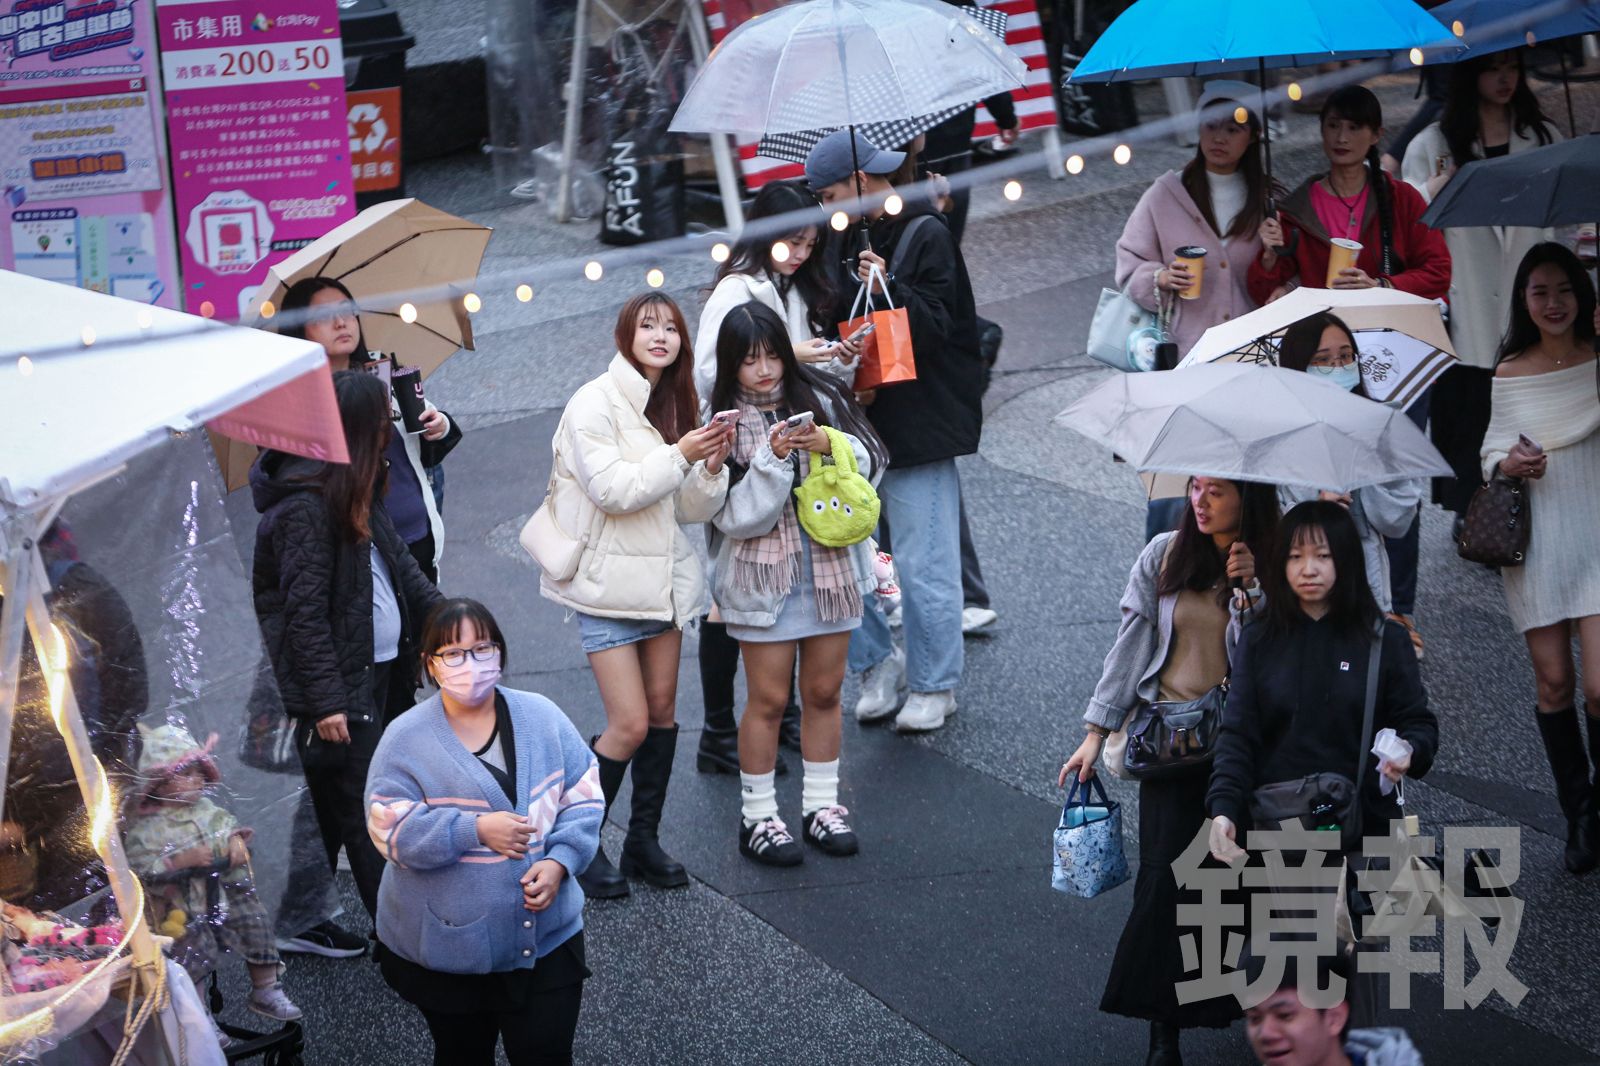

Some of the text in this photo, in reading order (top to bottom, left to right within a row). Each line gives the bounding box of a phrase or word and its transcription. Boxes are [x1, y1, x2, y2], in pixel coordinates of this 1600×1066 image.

[171, 15, 243, 42] 市集用
[612, 141, 645, 237] A-FUN
